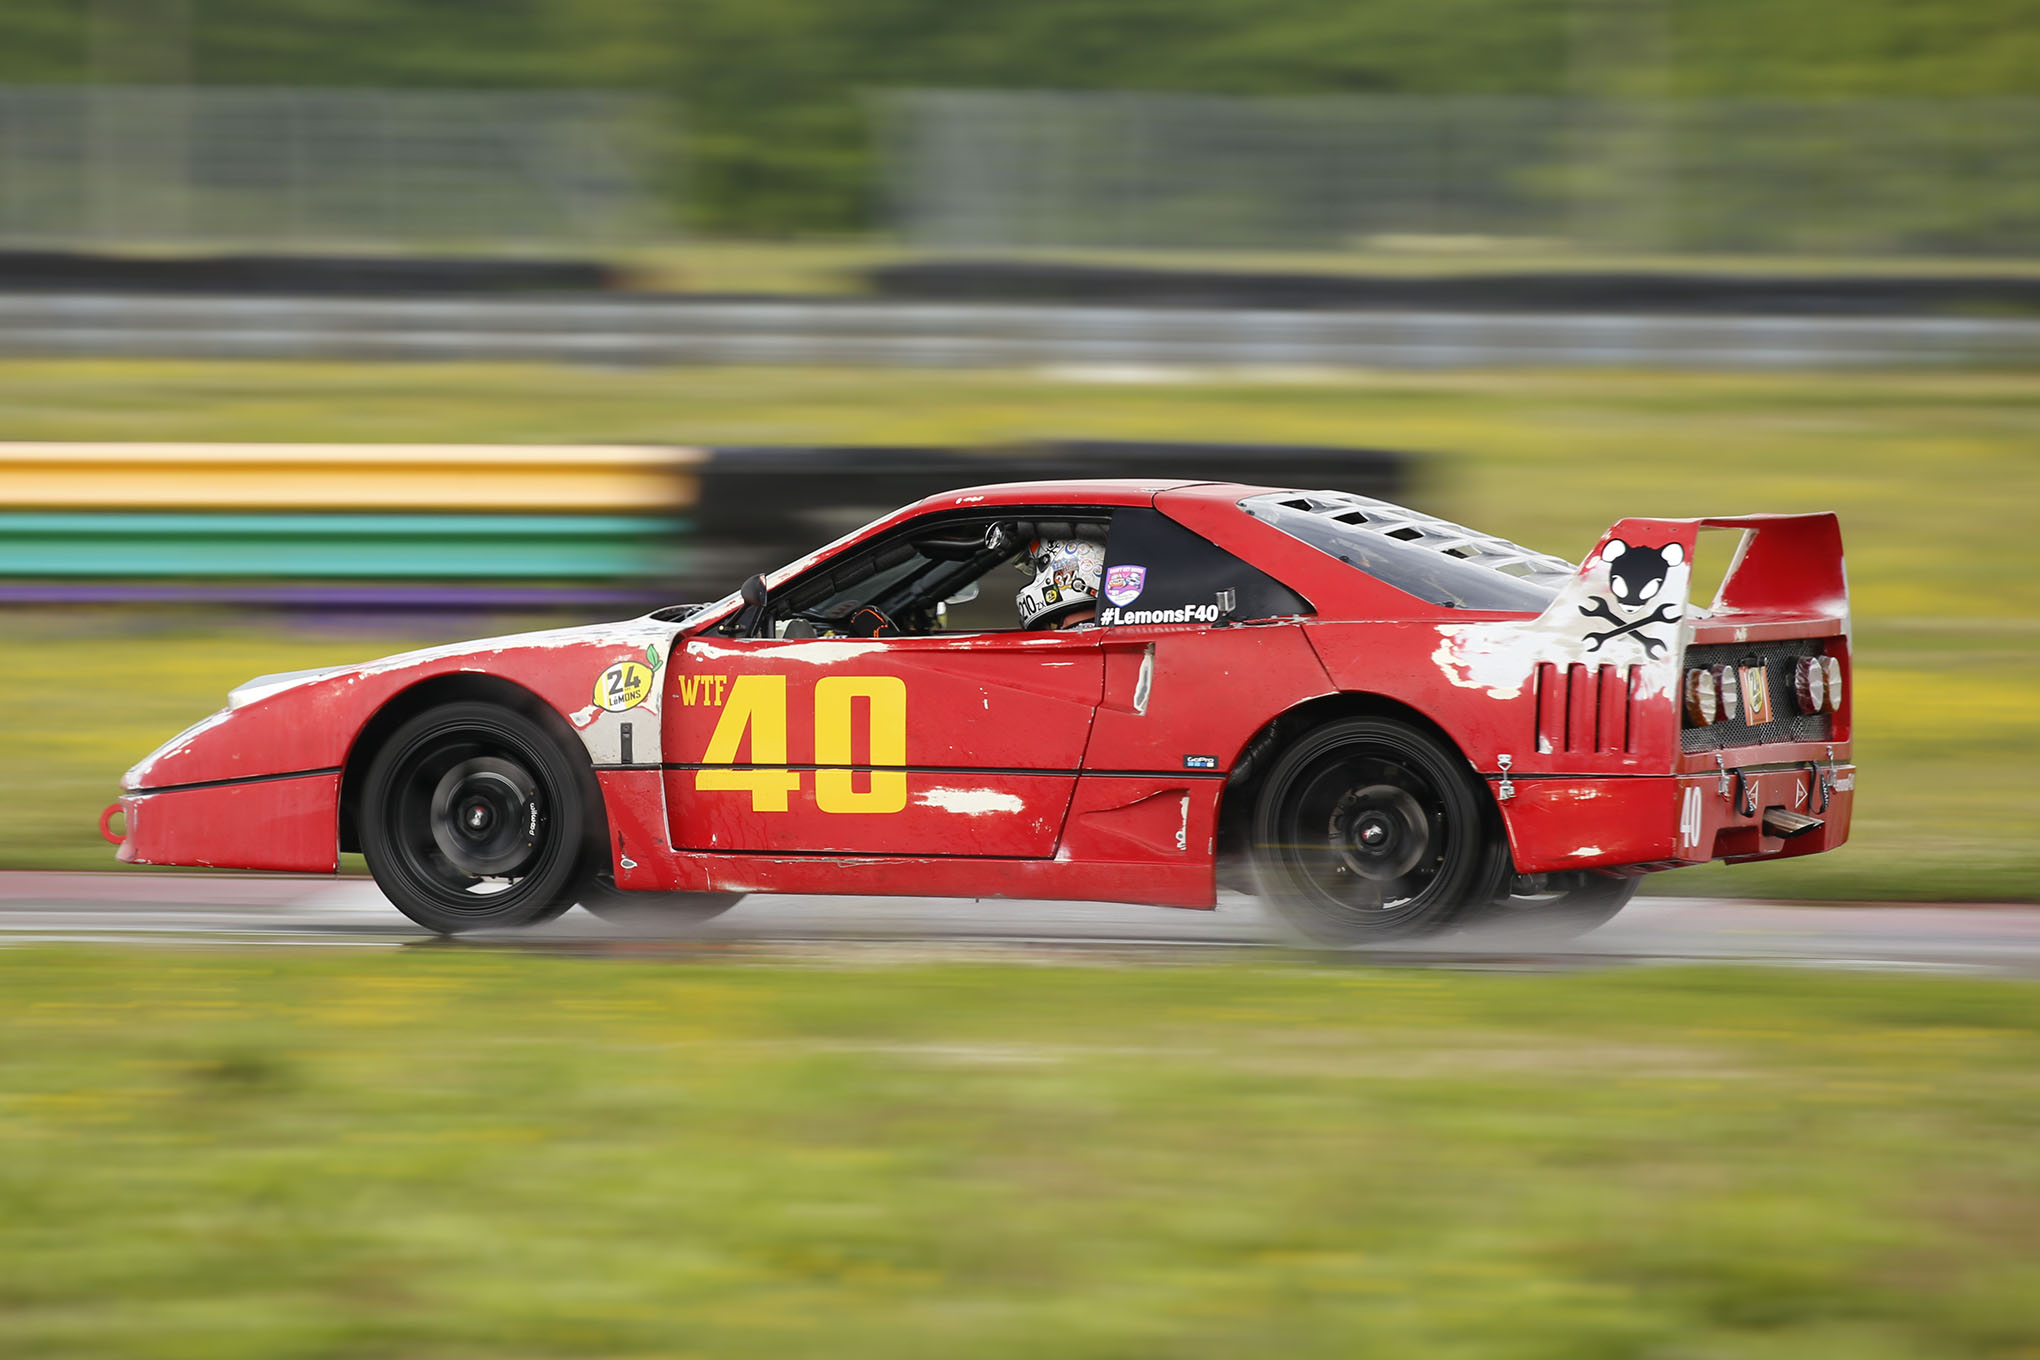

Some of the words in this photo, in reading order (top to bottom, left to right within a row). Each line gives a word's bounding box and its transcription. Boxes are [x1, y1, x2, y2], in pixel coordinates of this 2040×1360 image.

[1100, 604, 1219, 626] #LemonsF40
[607, 665, 641, 695] 24
[678, 674, 728, 706] WTF
[695, 674, 908, 814] 40
[1679, 786, 1703, 848] 40
